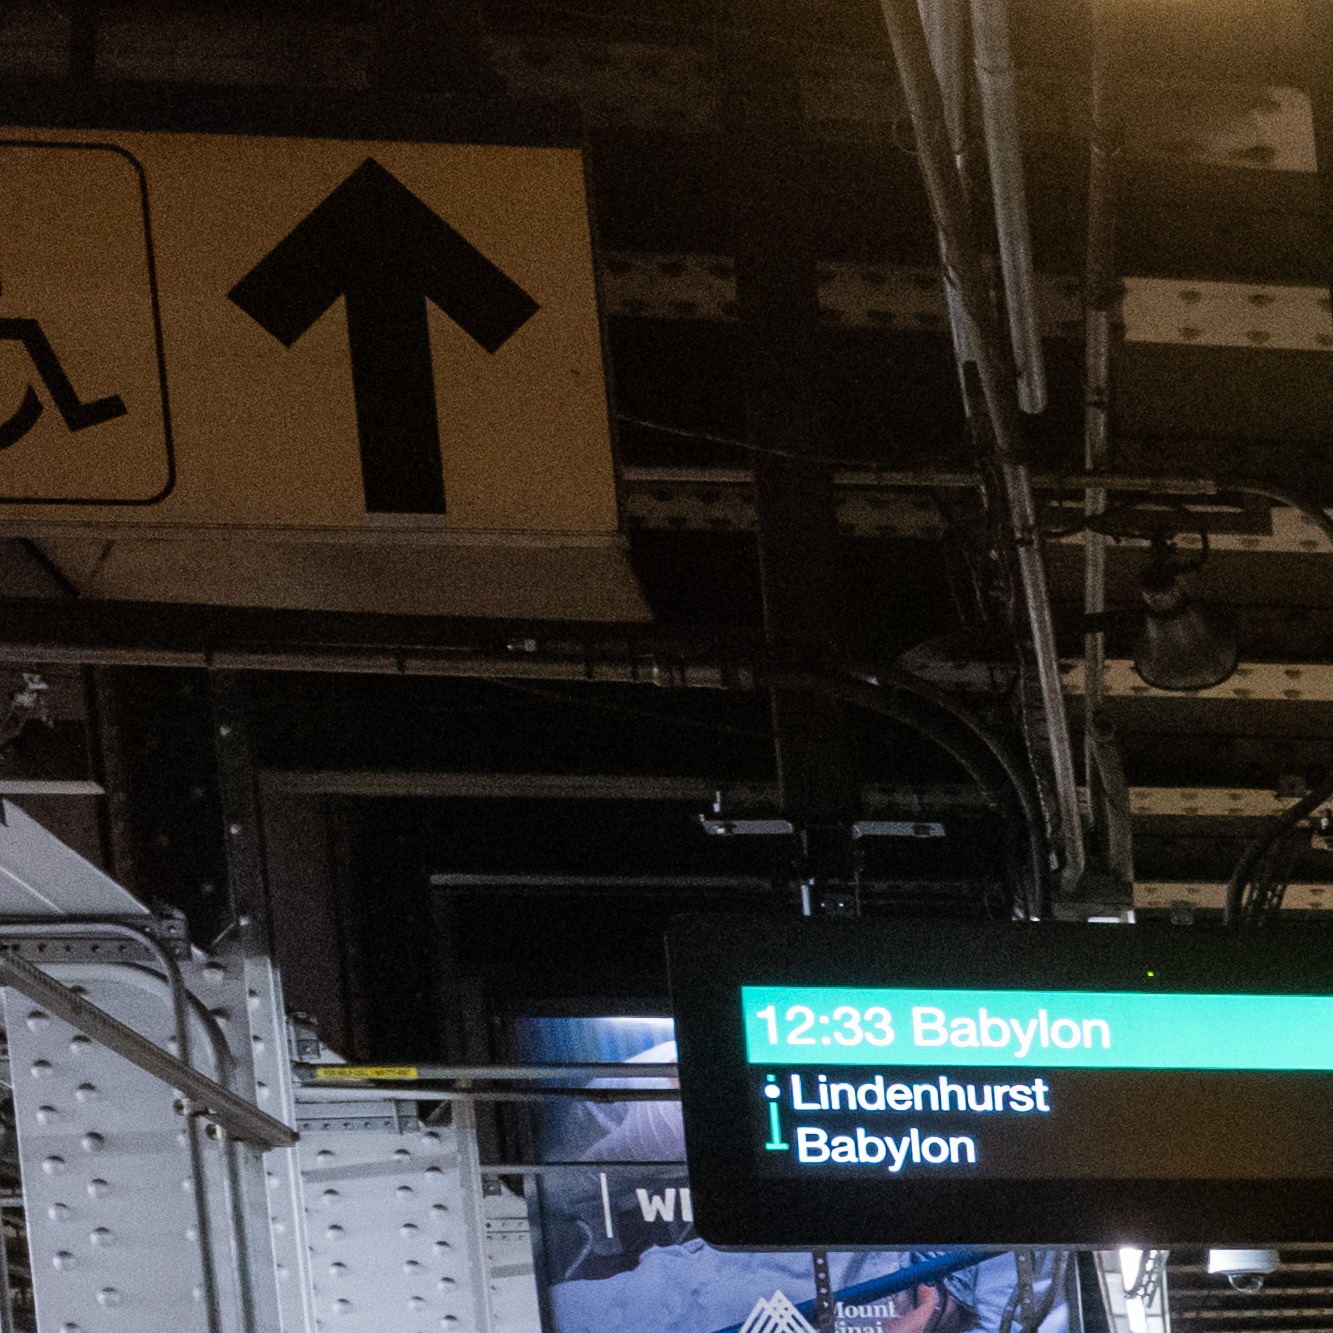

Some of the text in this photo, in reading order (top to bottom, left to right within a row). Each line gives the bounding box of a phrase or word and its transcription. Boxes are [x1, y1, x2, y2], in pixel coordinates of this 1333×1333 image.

[756, 1005, 896, 1048] 12:33
[911, 1005, 1112, 1055] Babylon
[790, 1073, 1051, 1113] Lindenhurst
[796, 1126, 977, 1173] Babylon
